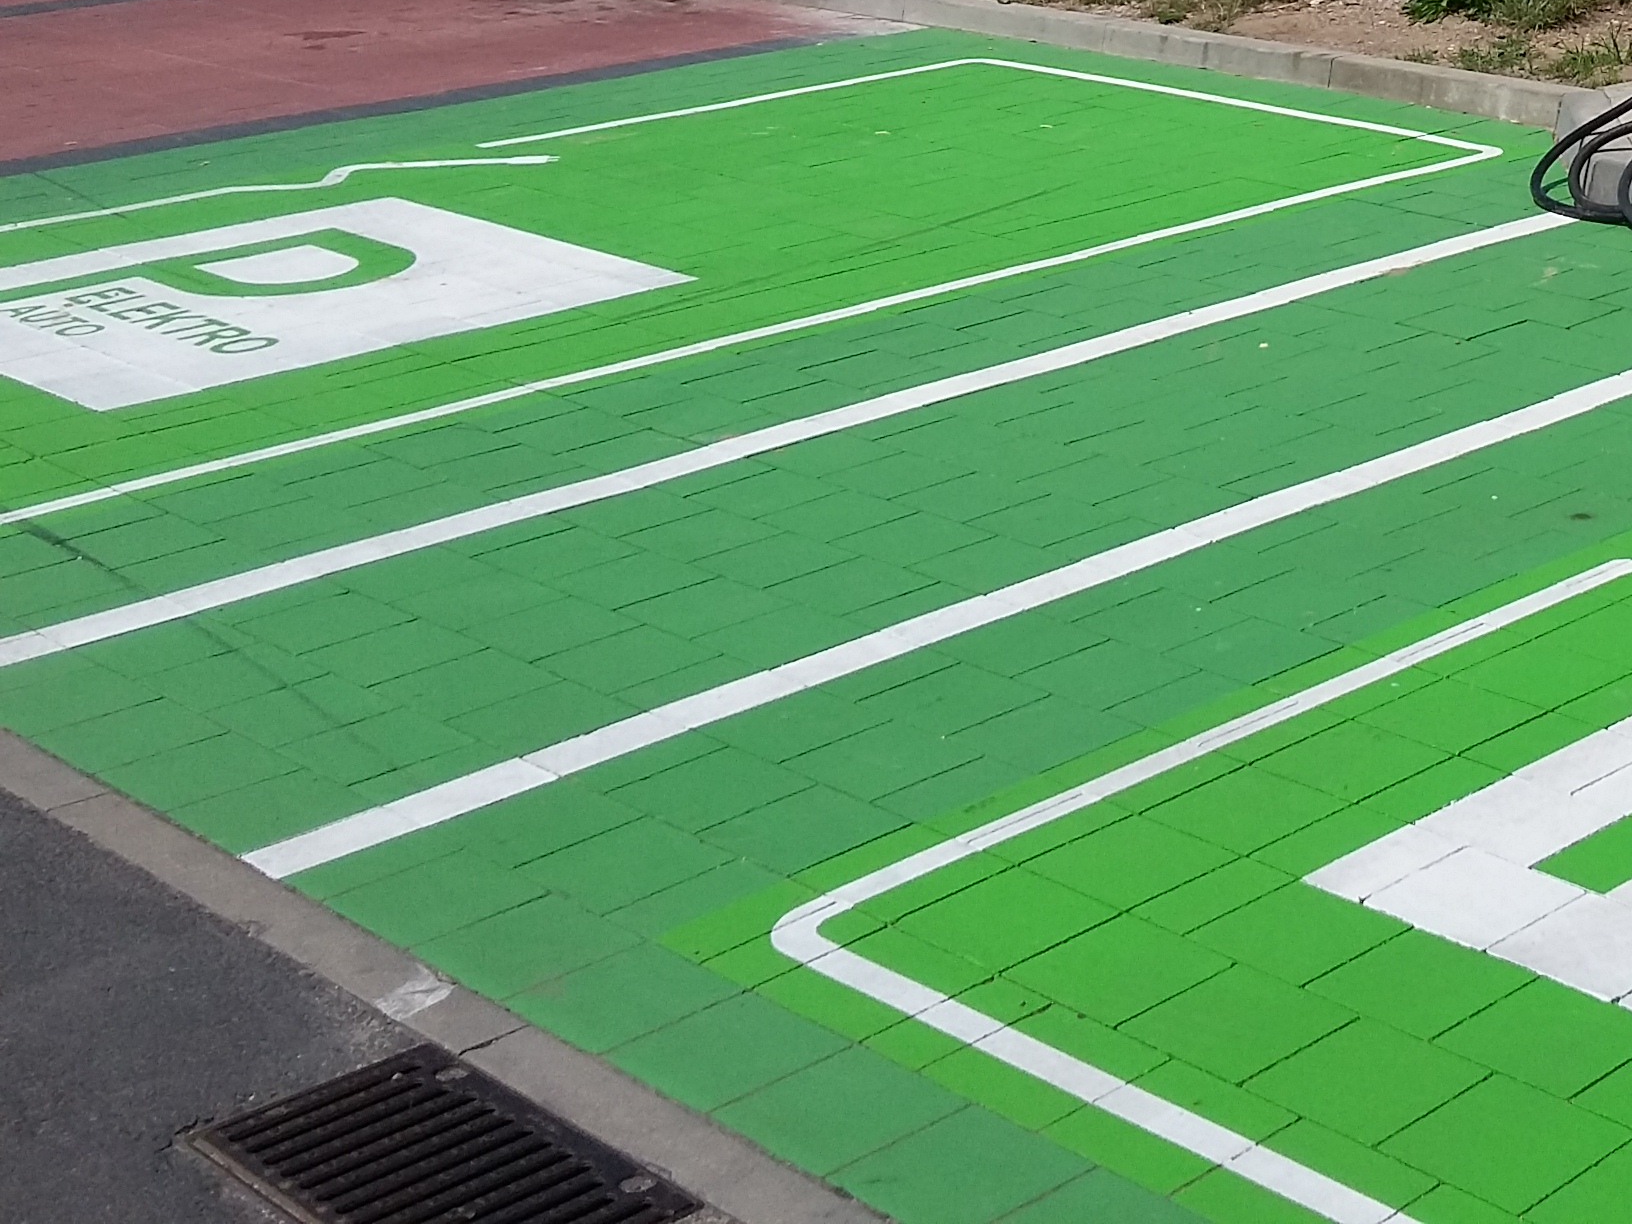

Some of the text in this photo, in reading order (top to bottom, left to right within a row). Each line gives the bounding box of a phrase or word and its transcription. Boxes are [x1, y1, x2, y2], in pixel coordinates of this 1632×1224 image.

[0, 227, 417, 303] P
[0, 304, 105, 337] AUTO
[65, 287, 279, 354] ELEKTRO
